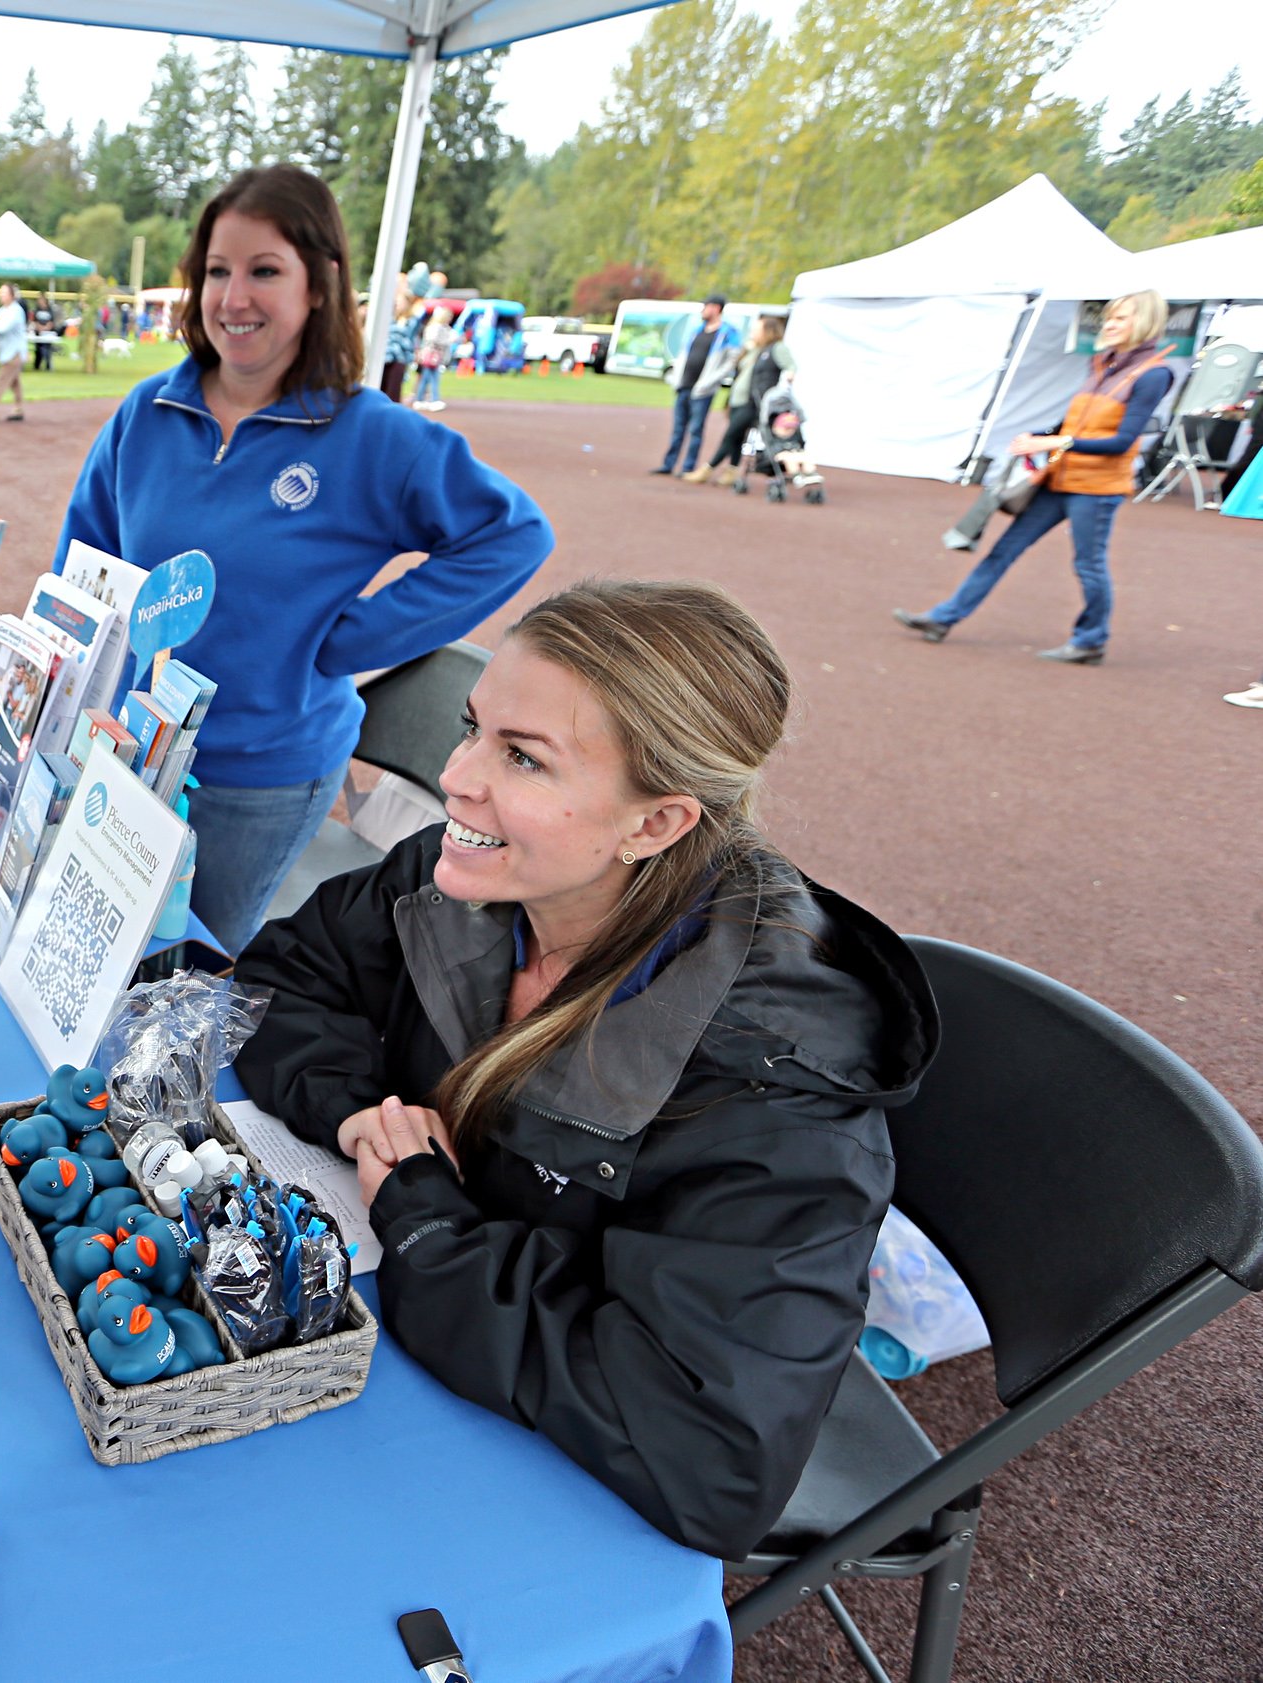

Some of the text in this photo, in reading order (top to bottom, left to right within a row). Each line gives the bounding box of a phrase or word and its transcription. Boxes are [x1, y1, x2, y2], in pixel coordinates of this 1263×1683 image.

[137, 583, 204, 625] Українська
[101, 827, 152, 887] Emergency Management
[107, 805, 160, 873] Pierce County
